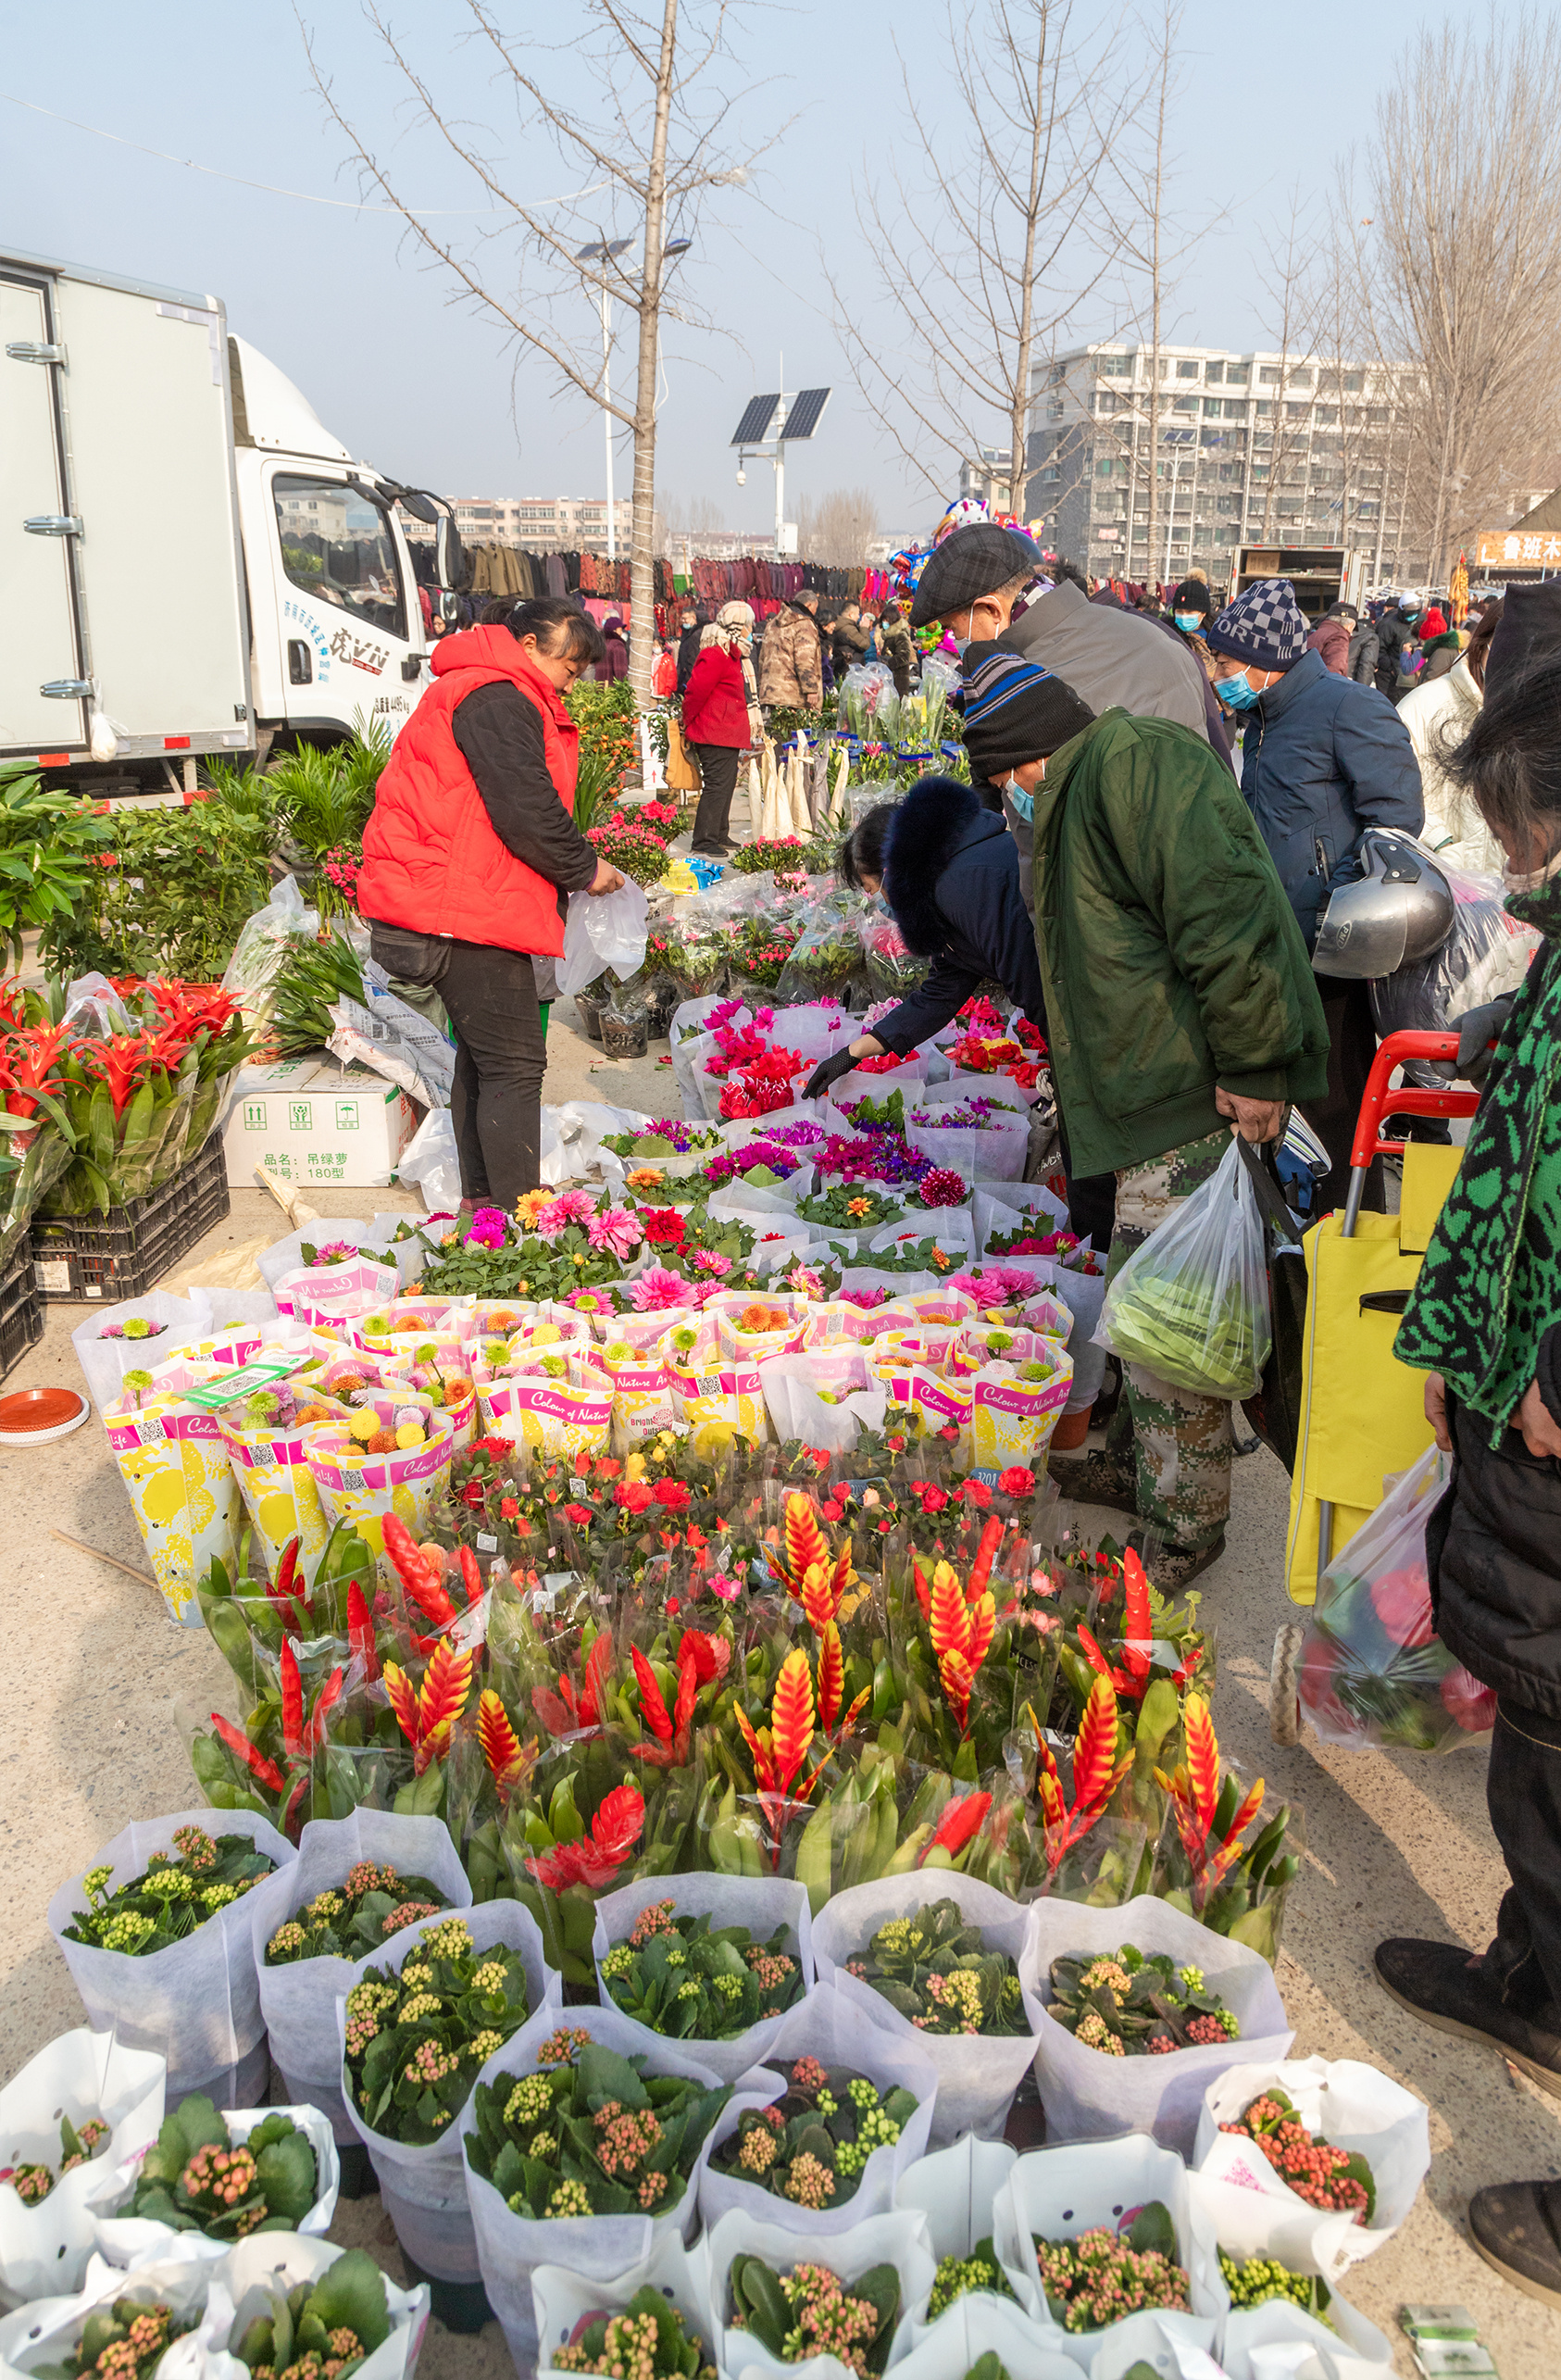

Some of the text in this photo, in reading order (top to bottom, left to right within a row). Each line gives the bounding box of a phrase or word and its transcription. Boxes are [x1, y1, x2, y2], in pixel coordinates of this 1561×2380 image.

[1503, 535, 1561, 560] 鲁班木
[307, 1153, 348, 1166] 吊绿萝
[307, 1167, 345, 1179] 180型
[617, 1376, 651, 1388] Nature
[531, 1391, 566, 1414] Colour
[567, 1409, 576, 1422] of
[920, 1385, 951, 1411] Colour
[983, 1386, 1019, 1409] Colour
[1021, 1402, 1030, 1414] of
[1031, 1397, 1055, 1412] Nature
[631, 1418, 654, 1426] Bright
[403, 1460, 433, 1478] Colour
